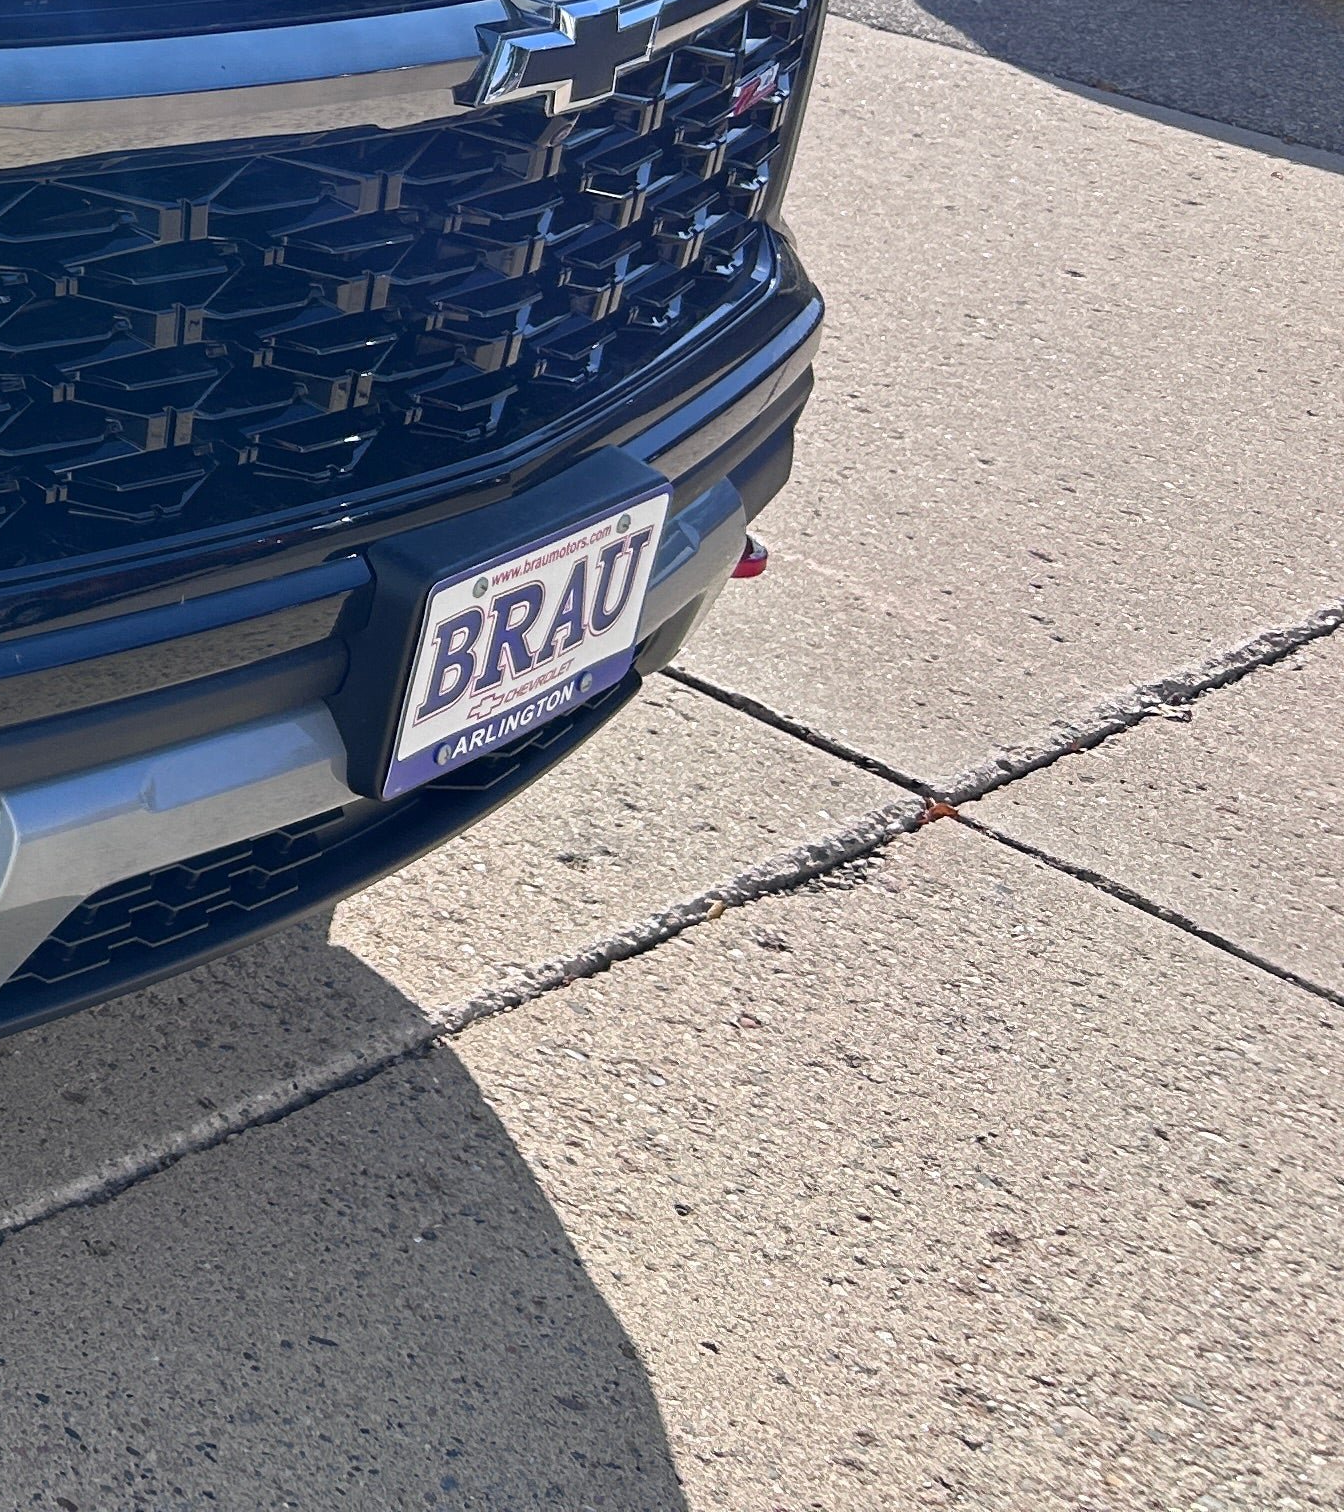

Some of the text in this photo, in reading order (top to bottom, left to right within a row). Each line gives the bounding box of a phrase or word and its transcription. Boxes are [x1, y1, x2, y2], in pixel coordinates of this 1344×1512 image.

[491, 525, 612, 587] www.braumotors.com
[413, 526, 653, 727] BRAU
[504, 657, 575, 703] CHEVROLET
[450, 681, 574, 759] ARLINGTON
